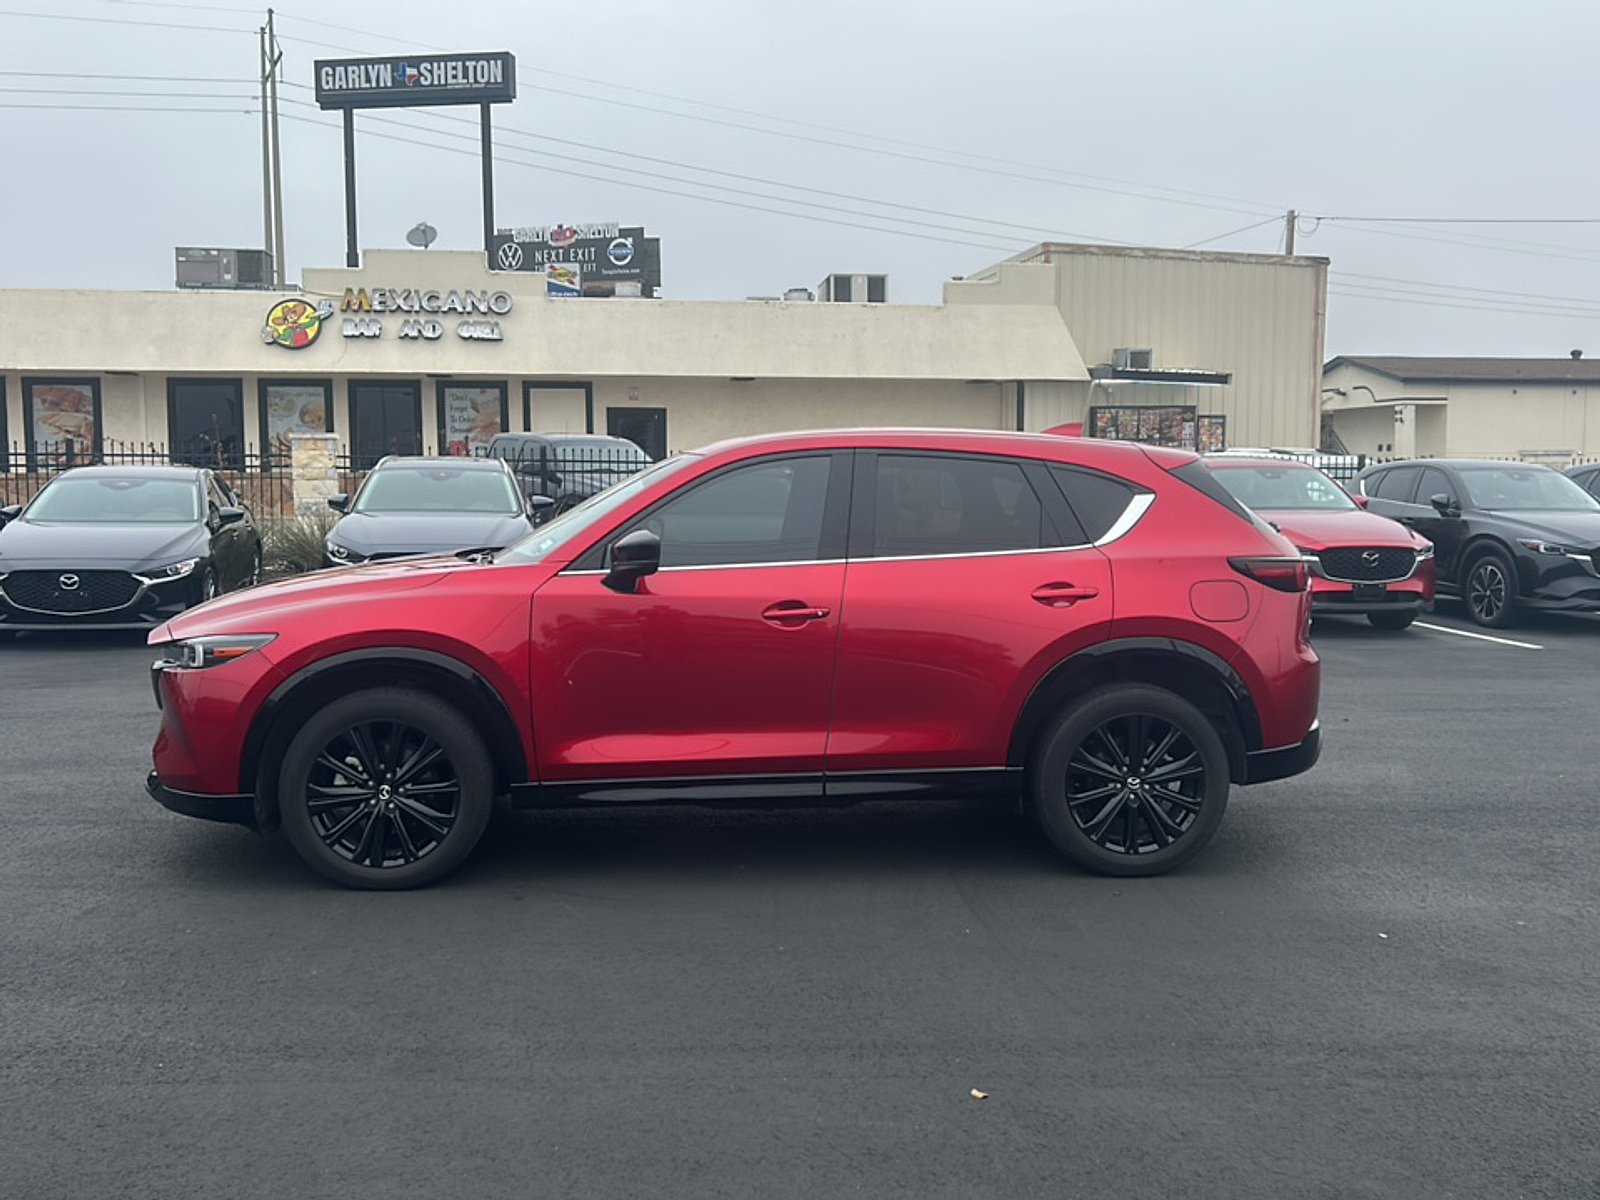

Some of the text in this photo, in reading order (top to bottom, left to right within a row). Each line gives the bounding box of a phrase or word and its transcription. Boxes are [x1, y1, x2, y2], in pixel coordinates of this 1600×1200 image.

[321, 59, 503, 90] GARLYN SHELTON
[534, 247, 597, 263] NEXT EXIT
[341, 286, 513, 316] MEXICANO
[342, 318, 382, 339] BAR
[399, 319, 444, 340] AND
